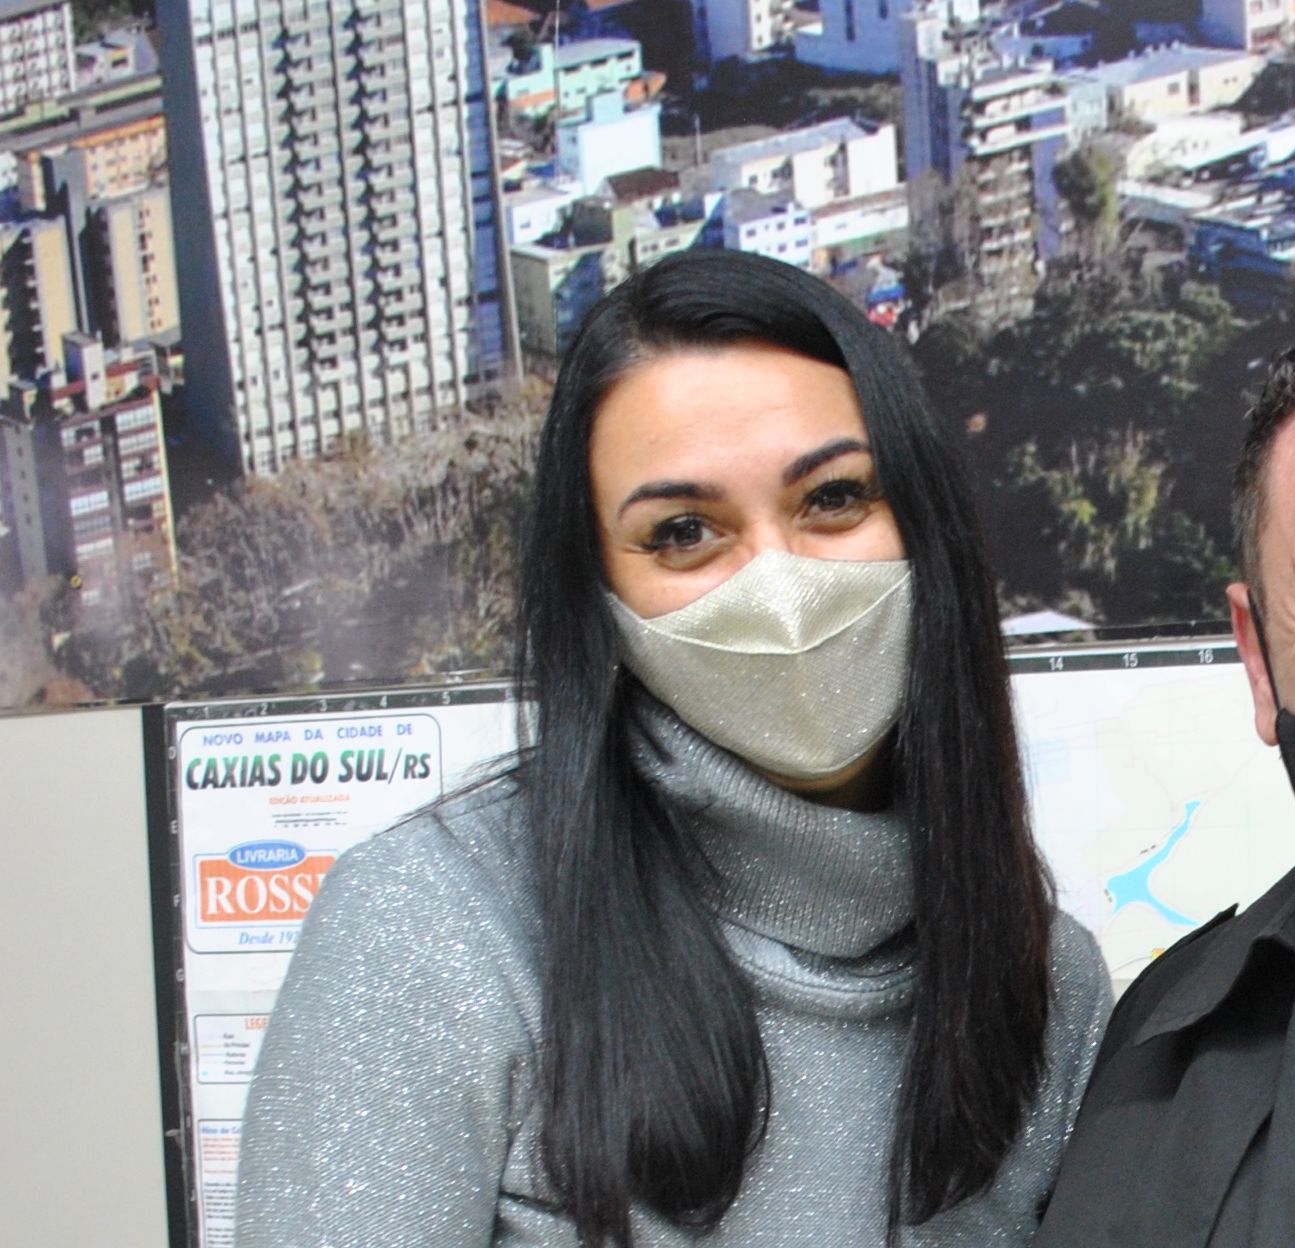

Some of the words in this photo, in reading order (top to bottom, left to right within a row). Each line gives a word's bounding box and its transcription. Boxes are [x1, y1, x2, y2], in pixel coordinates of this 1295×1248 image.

[1122, 652, 1139, 668] 15
[1198, 648, 1214, 663] 16
[1048, 656, 1065, 672] 14
[260, 702, 269, 715] 2
[379, 694, 388, 708] 4
[202, 732, 244, 747] NOVO
[254, 729, 292, 745] MAPA
[303, 727, 324, 741] DA
[336, 725, 384, 740] CIDADE
[396, 723, 413, 736] DE
[185, 753, 281, 791] CAXIAS
[290, 750, 330, 786] DO
[337, 747, 432, 785] SUL/RS
[235, 849, 299, 864] LIVRARIA
[238, 931, 274, 945] Desde
